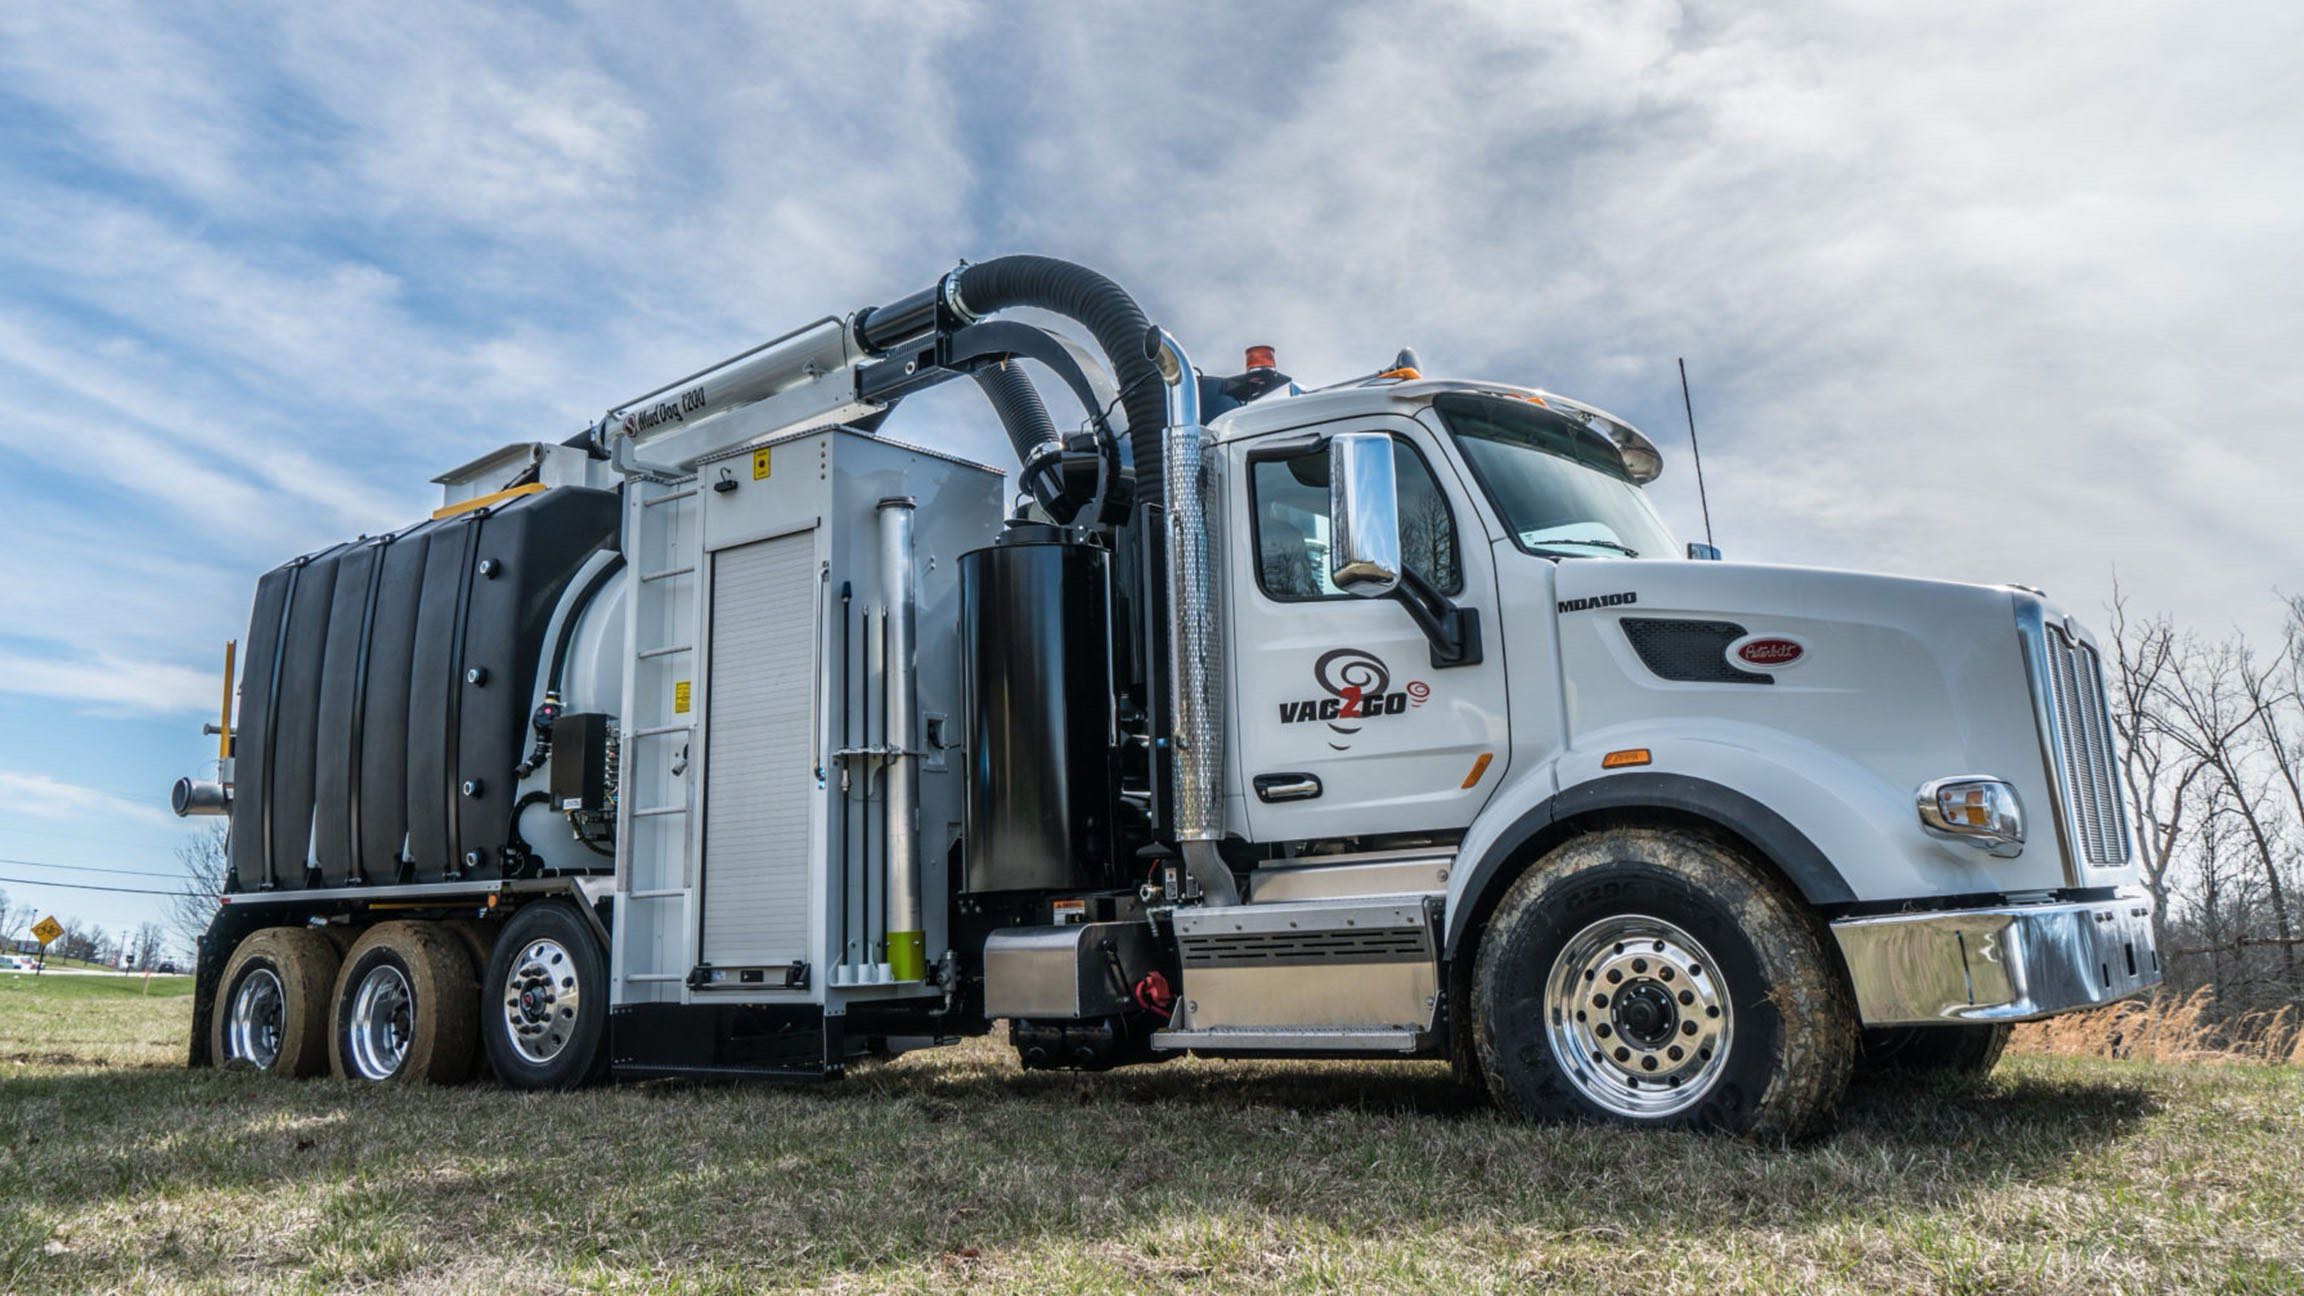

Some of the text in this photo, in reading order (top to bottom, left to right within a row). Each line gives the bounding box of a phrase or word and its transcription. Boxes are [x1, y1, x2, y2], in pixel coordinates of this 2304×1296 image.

[638, 404, 660, 431] Mud
[660, 403, 684, 422] Dog
[682, 386, 706, 413] 1200
[1557, 591, 1637, 614] MDA100
[1745, 644, 1797, 659] Peterbilt
[1279, 686, 1408, 724] VAC2GO
